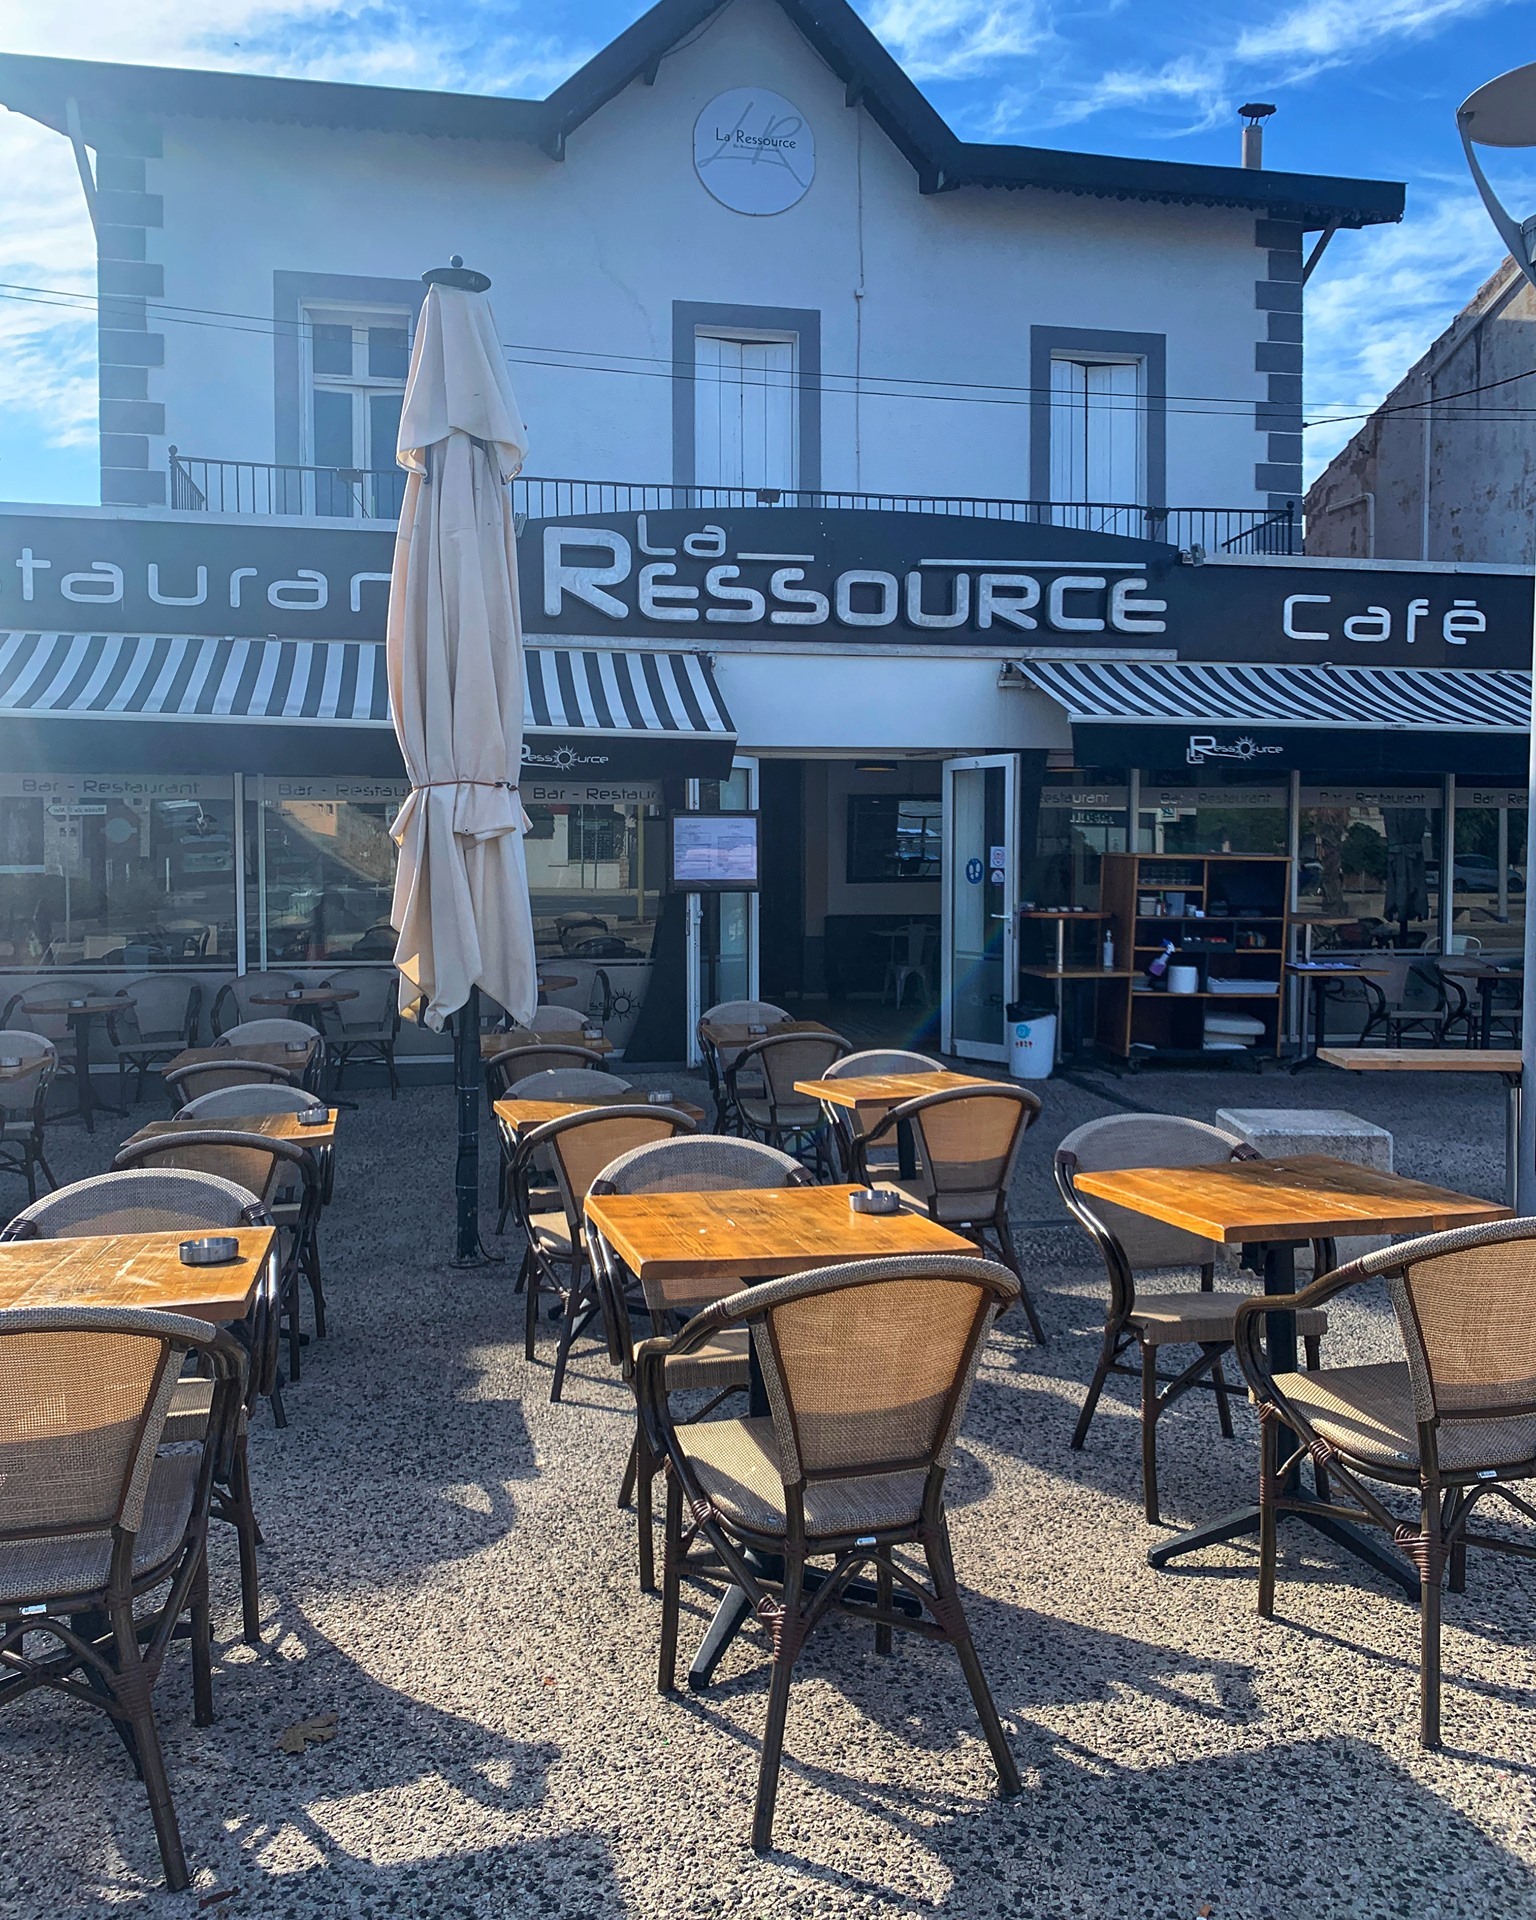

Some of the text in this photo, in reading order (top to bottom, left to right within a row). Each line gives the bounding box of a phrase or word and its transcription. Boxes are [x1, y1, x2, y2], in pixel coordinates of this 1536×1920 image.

[715, 127, 731, 142] La
[736, 129, 797, 149] Ressource
[0, 547, 391, 612] tauran
[22, 779, 59, 792] Bar
[83, 779, 201, 794] Restaurant
[278, 783, 312, 796] Bar
[533, 787, 566, 800] Bar
[586, 787, 657, 800] Restaur
[1473, 792, 1495, 804] Bar
